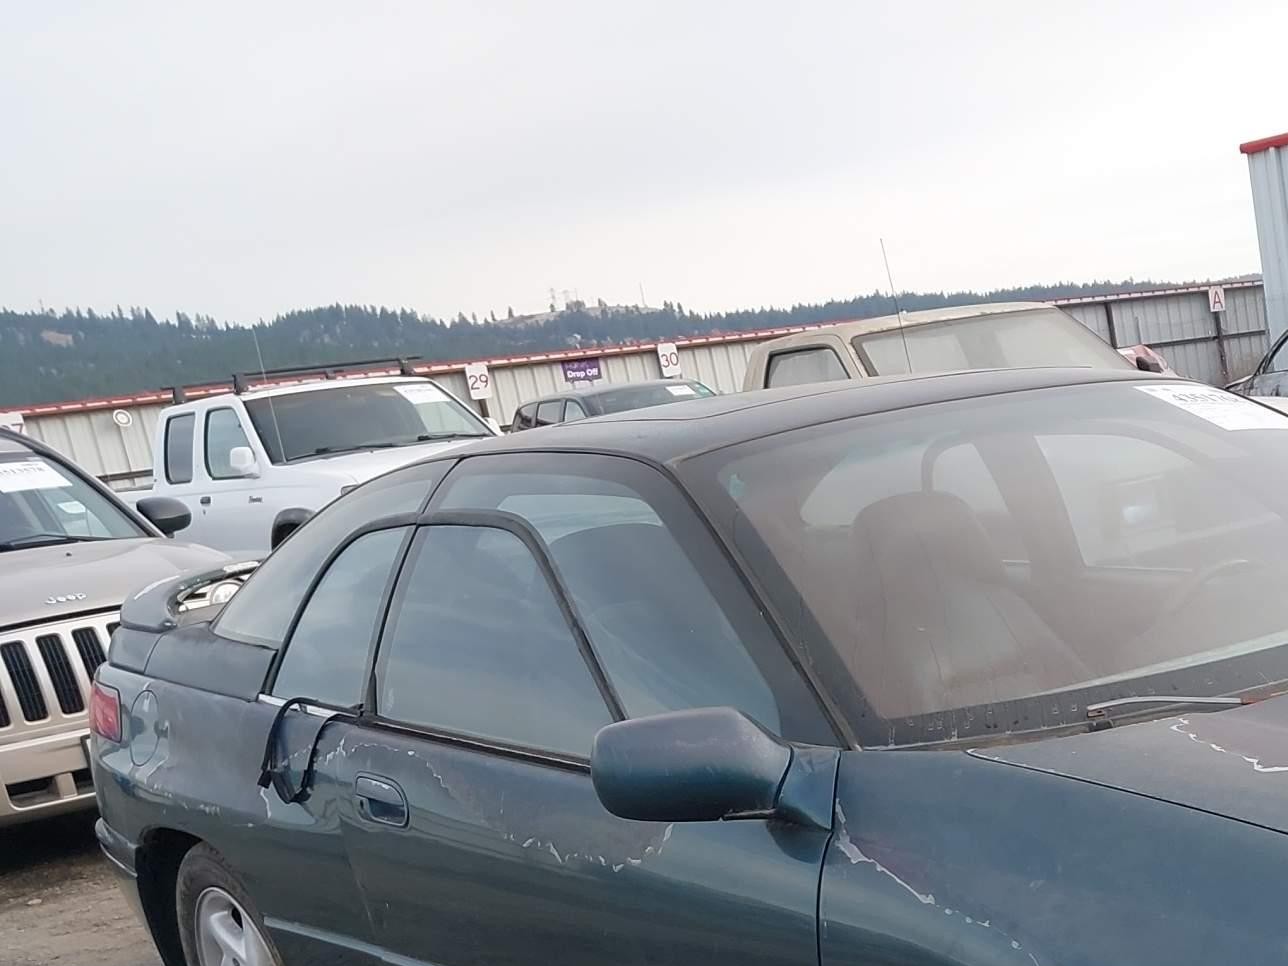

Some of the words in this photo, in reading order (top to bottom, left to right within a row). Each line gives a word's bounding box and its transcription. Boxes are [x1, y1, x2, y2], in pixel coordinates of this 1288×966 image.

[1212, 290, 1223, 309] A
[661, 352, 679, 368] 30
[567, 370, 586, 379] Drop
[586, 367, 599, 376] Off
[469, 374, 489, 390] 29
[44, 592, 88, 605] Jeep
